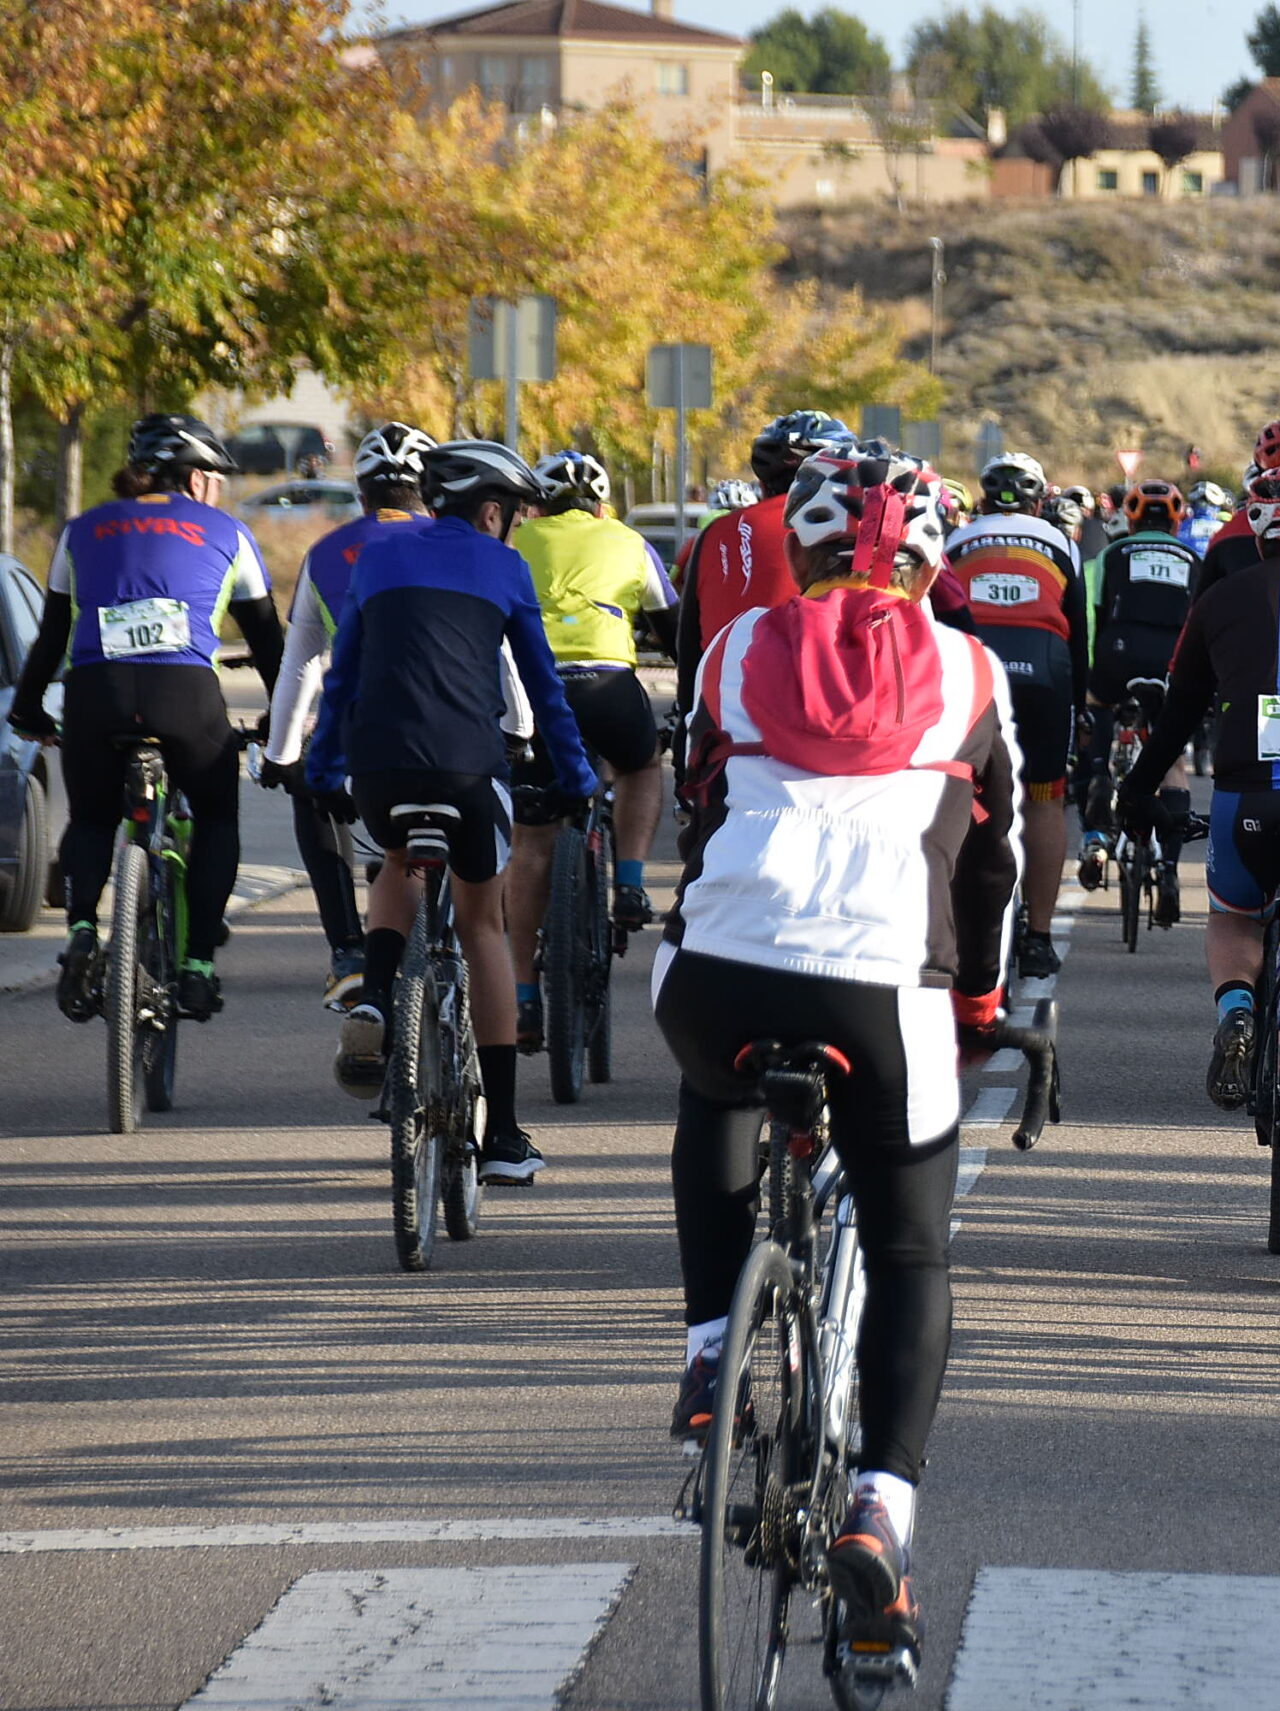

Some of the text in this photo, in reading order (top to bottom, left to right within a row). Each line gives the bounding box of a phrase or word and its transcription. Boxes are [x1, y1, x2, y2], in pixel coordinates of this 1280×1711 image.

[1149, 564, 1170, 578] 171
[988, 584, 1020, 601] 310
[125, 622, 165, 648] 102
